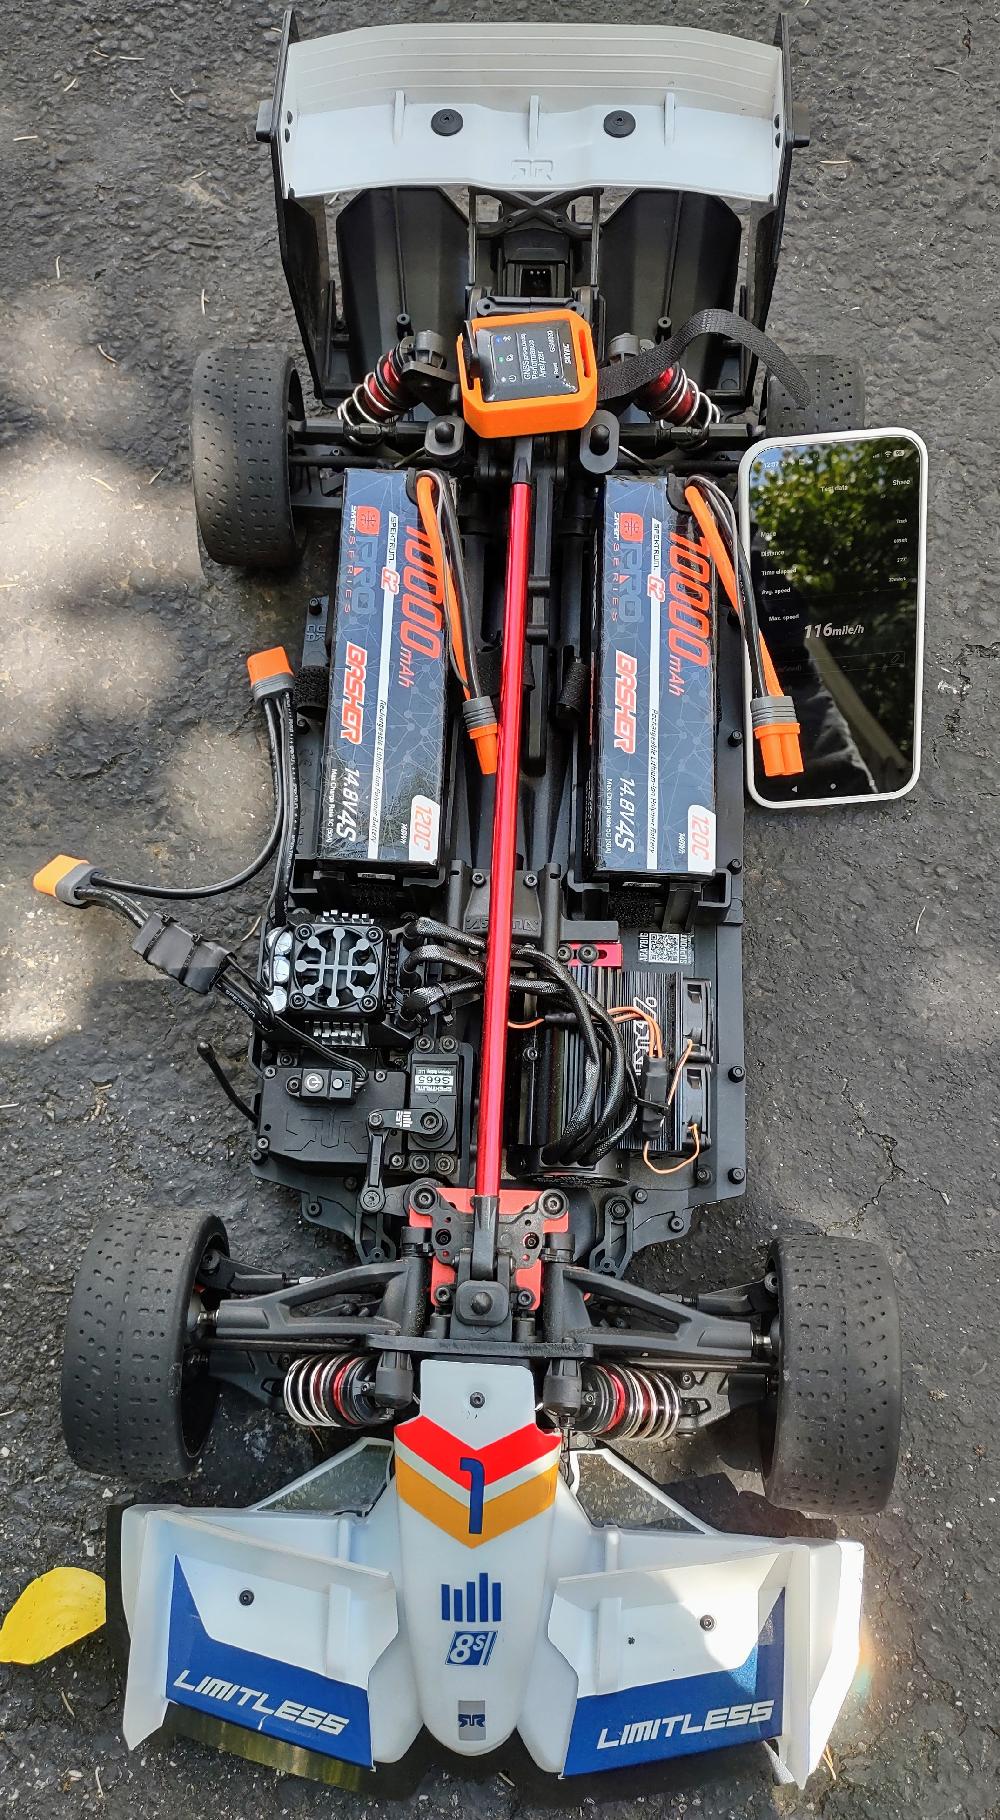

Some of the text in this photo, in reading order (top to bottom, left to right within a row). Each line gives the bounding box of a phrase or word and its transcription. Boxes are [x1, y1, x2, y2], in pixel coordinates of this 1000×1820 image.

[381, 567, 400, 595] G2
[647, 573, 666, 603] G2
[340, 641, 367, 745] BASHER
[613, 650, 637, 755] BASHER
[327, 782, 336, 803] Charge
[330, 768, 338, 781] Max
[336, 810, 357, 842] 4S
[412, 804, 433, 852] 120C
[615, 820, 635, 853] 4S
[691, 815, 710, 861] 120C
[417, 1076, 451, 1085] S665
[460, 1457, 485, 1534] 1
[173, 1669, 350, 1736] LIMITLESS
[597, 1700, 775, 1750] LIMITLESS
